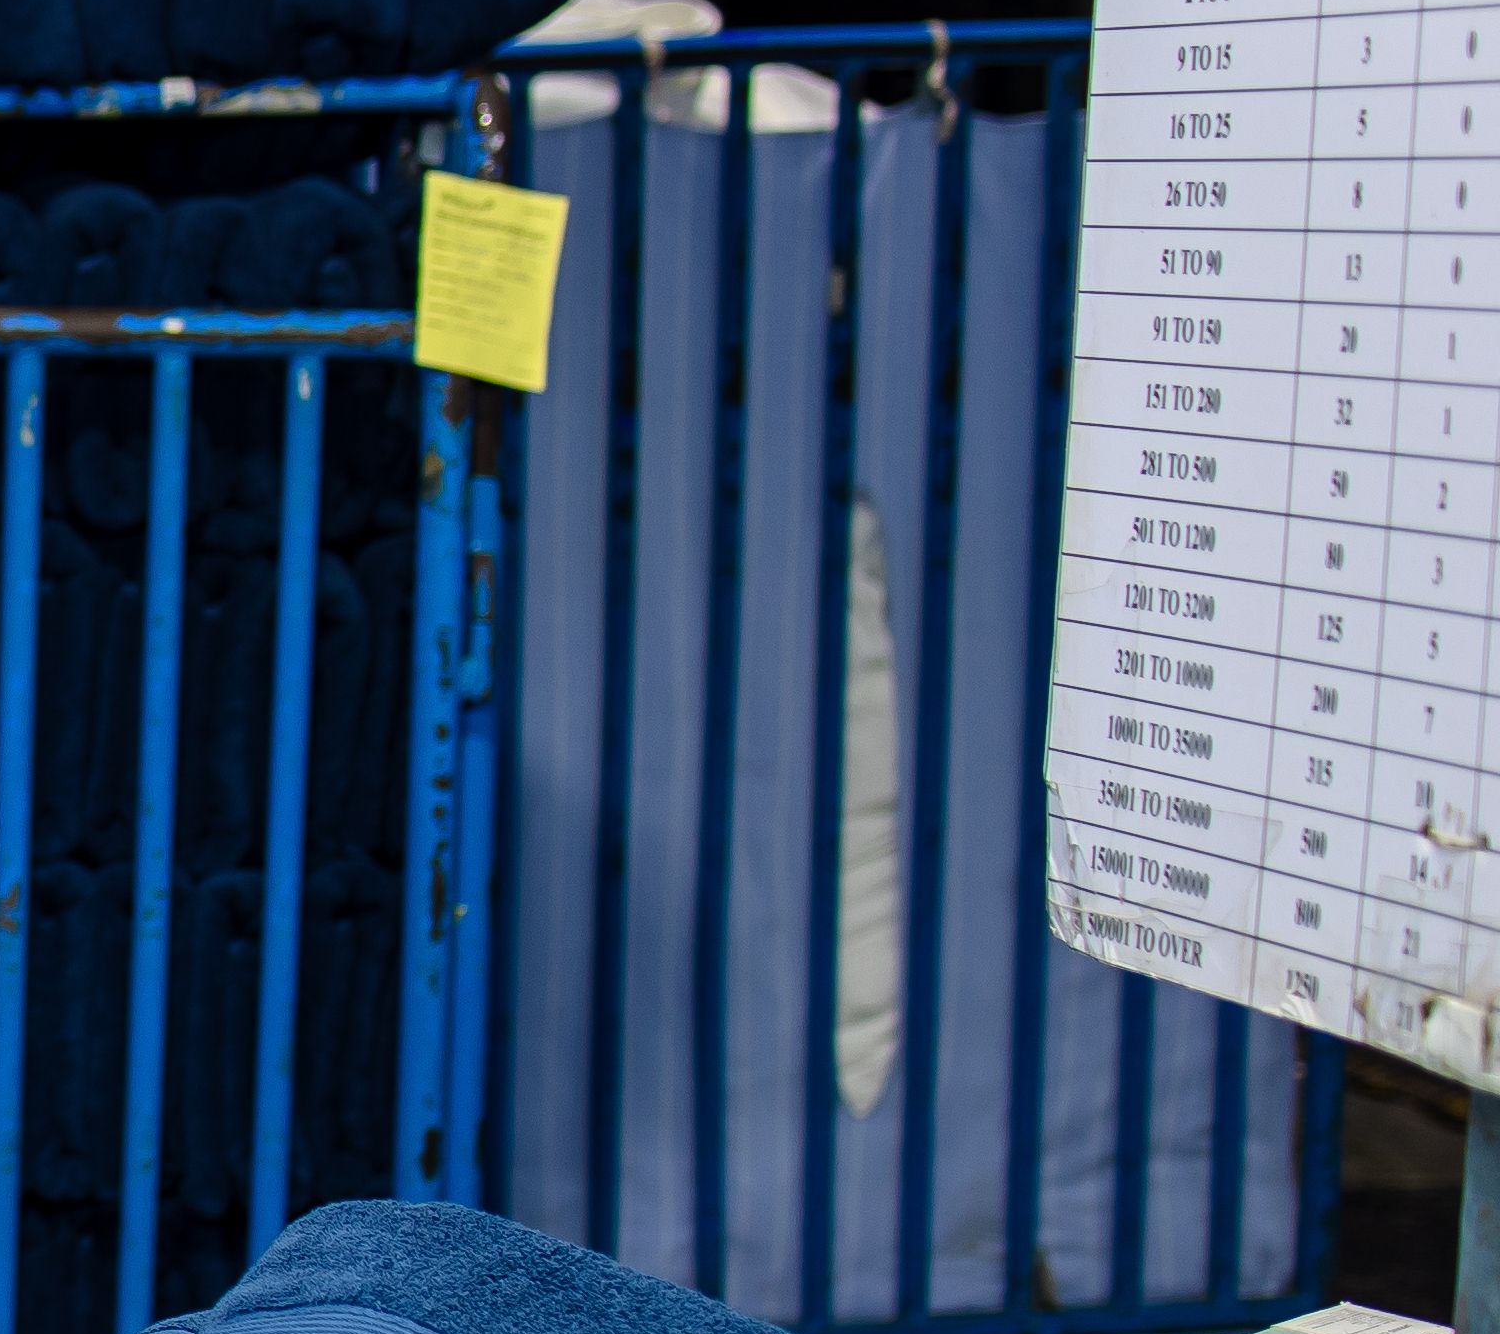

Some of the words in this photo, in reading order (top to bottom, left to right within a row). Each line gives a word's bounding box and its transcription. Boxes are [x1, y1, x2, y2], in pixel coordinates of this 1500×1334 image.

[1177, 46, 1186, 71] 9
[1190, 45, 1211, 70] TO
[1215, 44, 1232, 69] 15
[1362, 36, 1372, 64] 3
[1467, 30, 1478, 59] 0
[1171, 114, 1185, 139] 16
[1190, 114, 1211, 139] TO
[1215, 113, 1232, 139] 25
[1357, 109, 1367, 136] 5
[1462, 106, 1472, 134] 0
[1165, 181, 1181, 207] 26
[1185, 181, 1207, 207] TO
[1210, 181, 1226, 207] 50
[1457, 181, 1467, 209] 0
[1161, 249, 1176, 275] 51
[1181, 249, 1203, 275] TO
[1206, 250, 1222, 276] 90
[1346, 254, 1362, 281] 13
[1153, 317, 1168, 342] 91
[1172, 317, 1195, 343] TO
[1199, 319, 1222, 345] 150
[1340, 325, 1358, 353] 20
[1448, 332, 1456, 360] 1
[1146, 383, 1167, 410] 151
[1173, 385, 1194, 411] TO
[1197, 387, 1220, 414] 280
[1334, 398, 1353, 426] 32
[1443, 406, 1451, 435] 1
[1140, 450, 1163, 477] 281
[1168, 453, 1189, 480] TO
[1193, 455, 1216, 483] 500
[1330, 471, 1349, 498] 50
[1437, 481, 1447, 510] 2
[1132, 517, 1154, 544] 501
[1159, 521, 1180, 547] TO
[1185, 523, 1216, 552] 1200
[1124, 583, 1154, 611] 1201
[1159, 588, 1180, 615] TO
[1183, 591, 1215, 621] 3200
[1317, 615, 1343, 643] 125
[1428, 631, 1438, 659] 5
[1114, 649, 1145, 678] 3201
[1150, 655, 1171, 682] TO
[1108, 715, 1144, 746] 10001
[1149, 722, 1170, 751] TO
[1424, 705, 1435, 734] 7
[1098, 780, 1135, 811] 35001
[1140, 788, 1161, 817] TO
[1091, 845, 1133, 879] 150001
[1139, 856, 1159, 885] TO
[1134, 923, 1155, 953] TO
[1159, 931, 1203, 968] OVER
